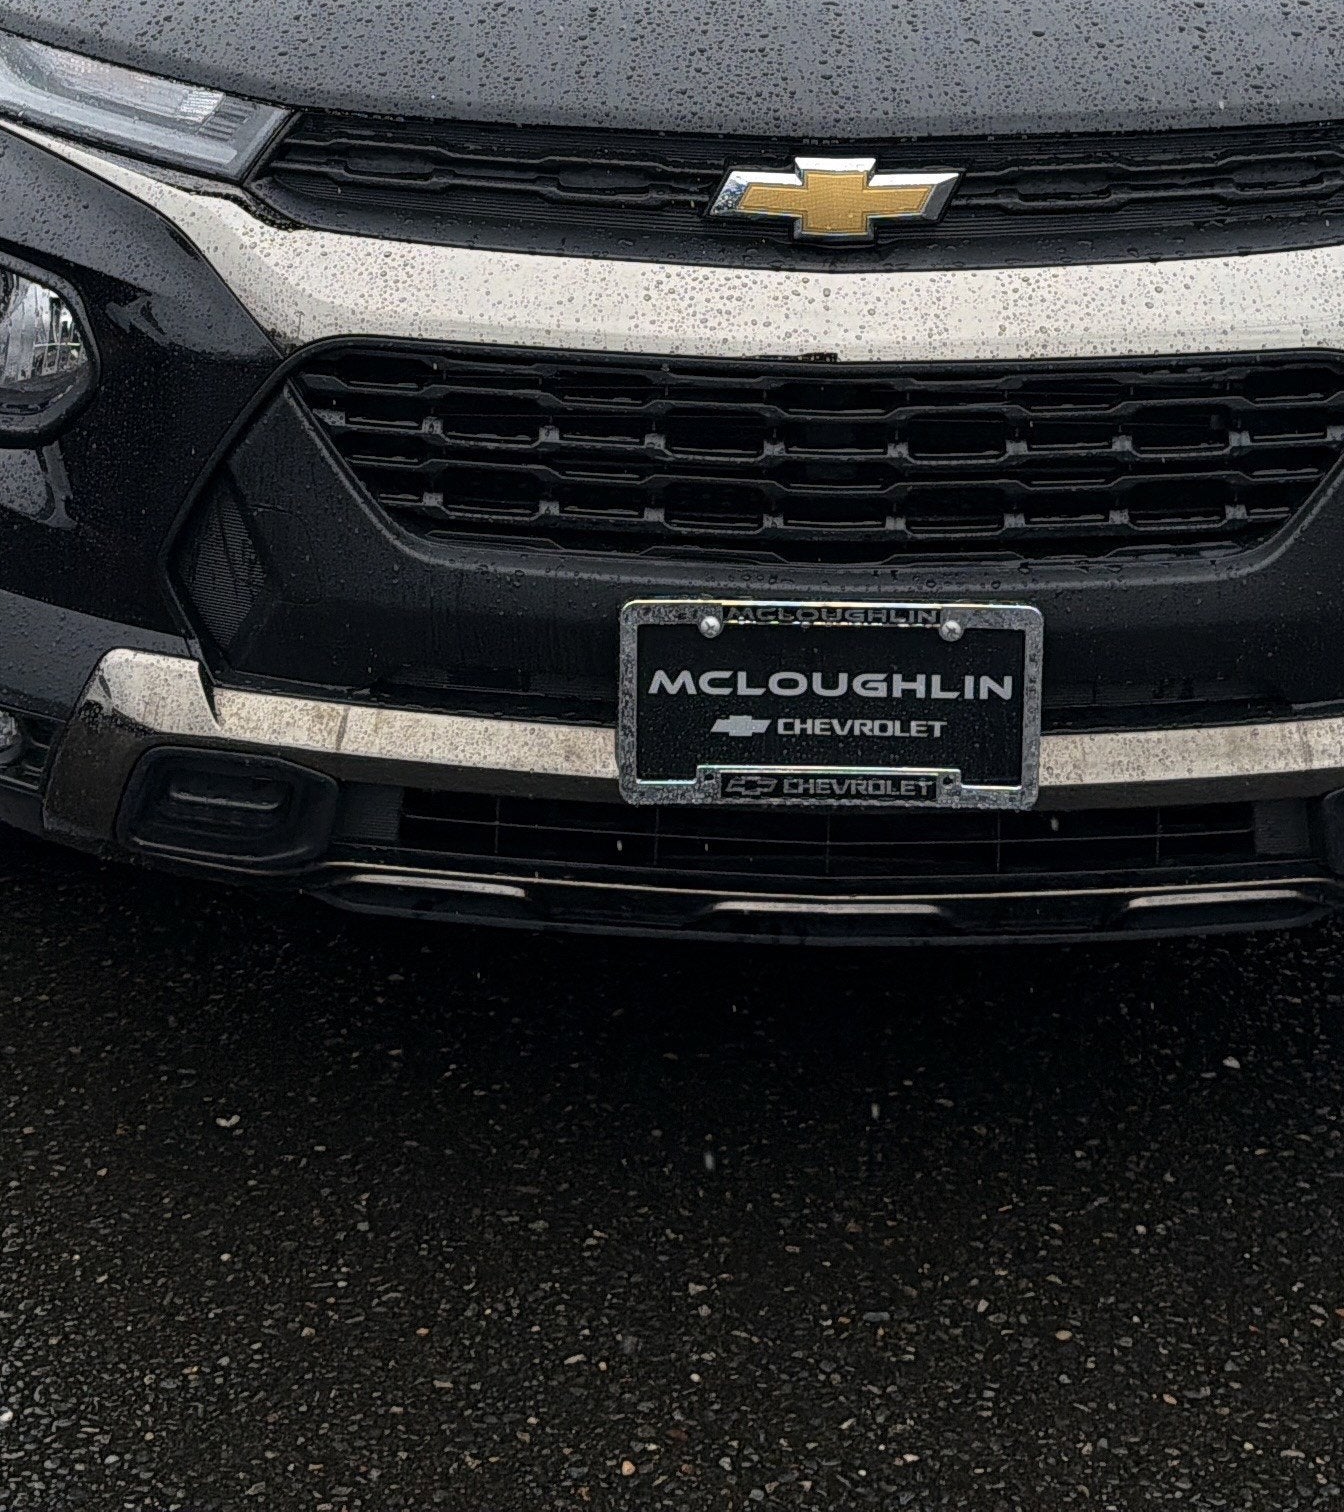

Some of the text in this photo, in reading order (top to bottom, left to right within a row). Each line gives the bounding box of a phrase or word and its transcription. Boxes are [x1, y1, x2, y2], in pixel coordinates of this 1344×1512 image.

[727, 606, 938, 624] MCLOUGHLIN
[647, 670, 1013, 700] MCLOUGHLIN
[777, 718, 948, 738] CHEVROLET
[782, 779, 936, 797] CHEVROLET
